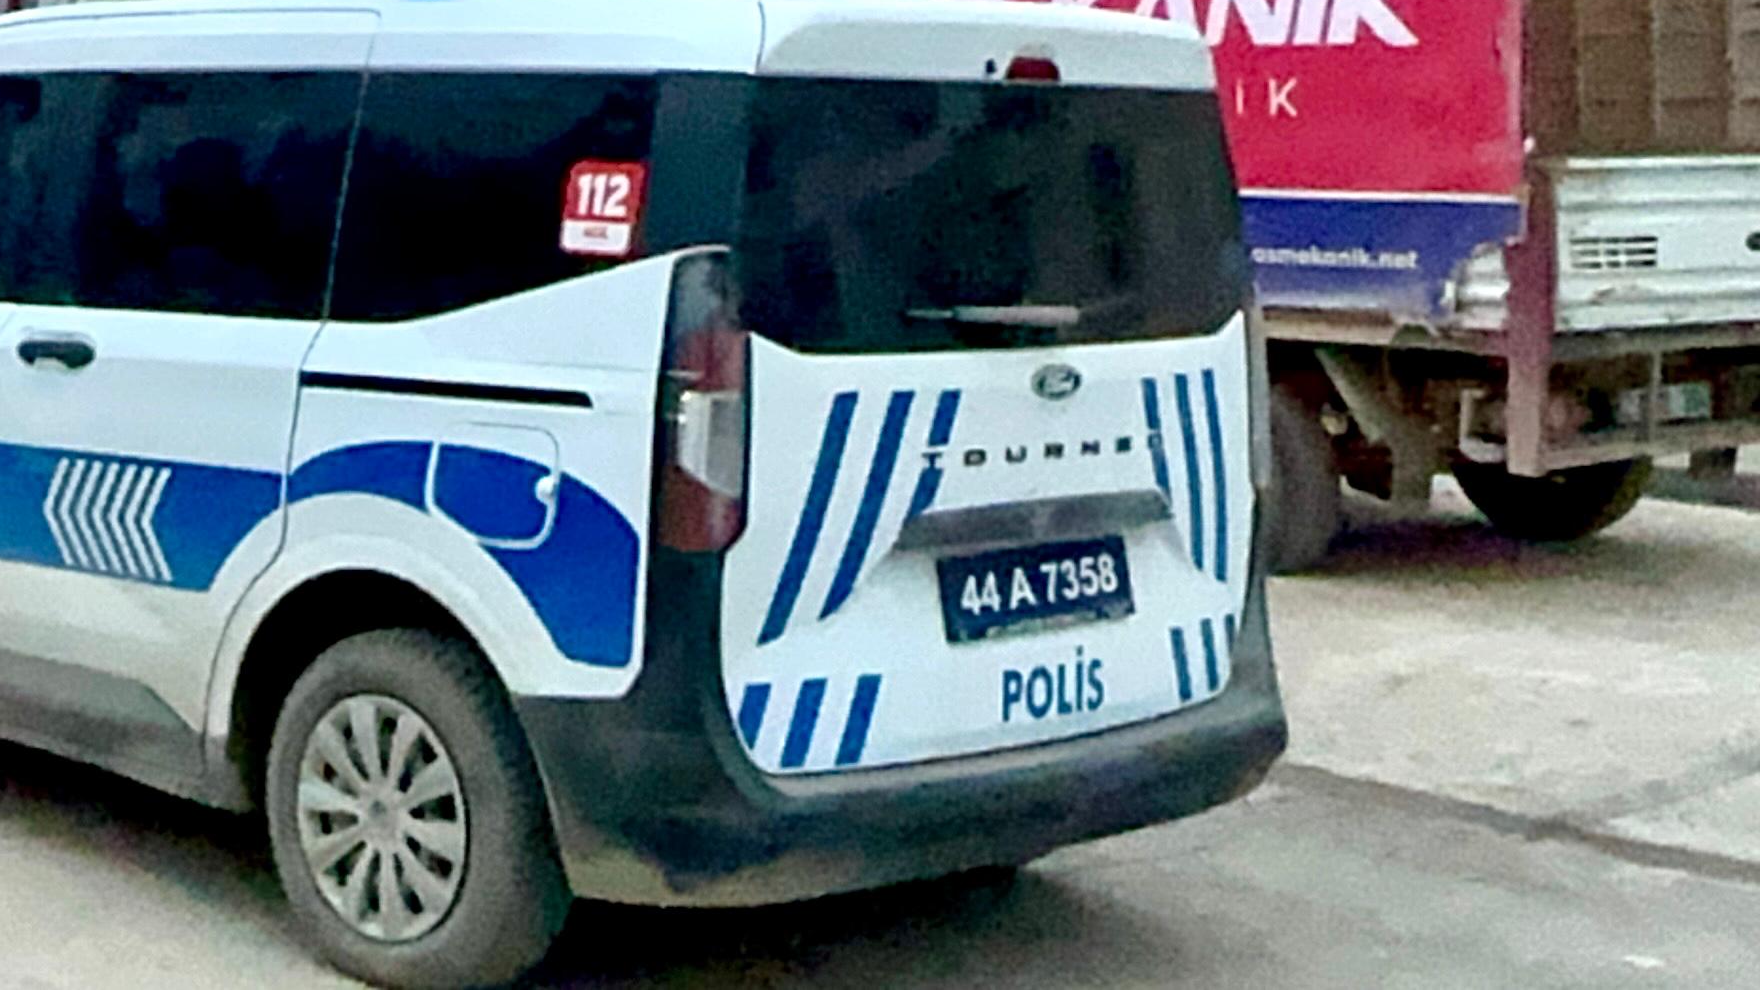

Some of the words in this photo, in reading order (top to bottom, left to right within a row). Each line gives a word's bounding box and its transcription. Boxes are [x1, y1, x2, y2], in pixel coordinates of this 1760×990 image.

[576, 172, 632, 218] 112
[960, 571, 1002, 616] 44
[1009, 566, 1039, 610] A
[1040, 553, 1119, 604] 7358
[1001, 644, 1105, 723] POLİS
